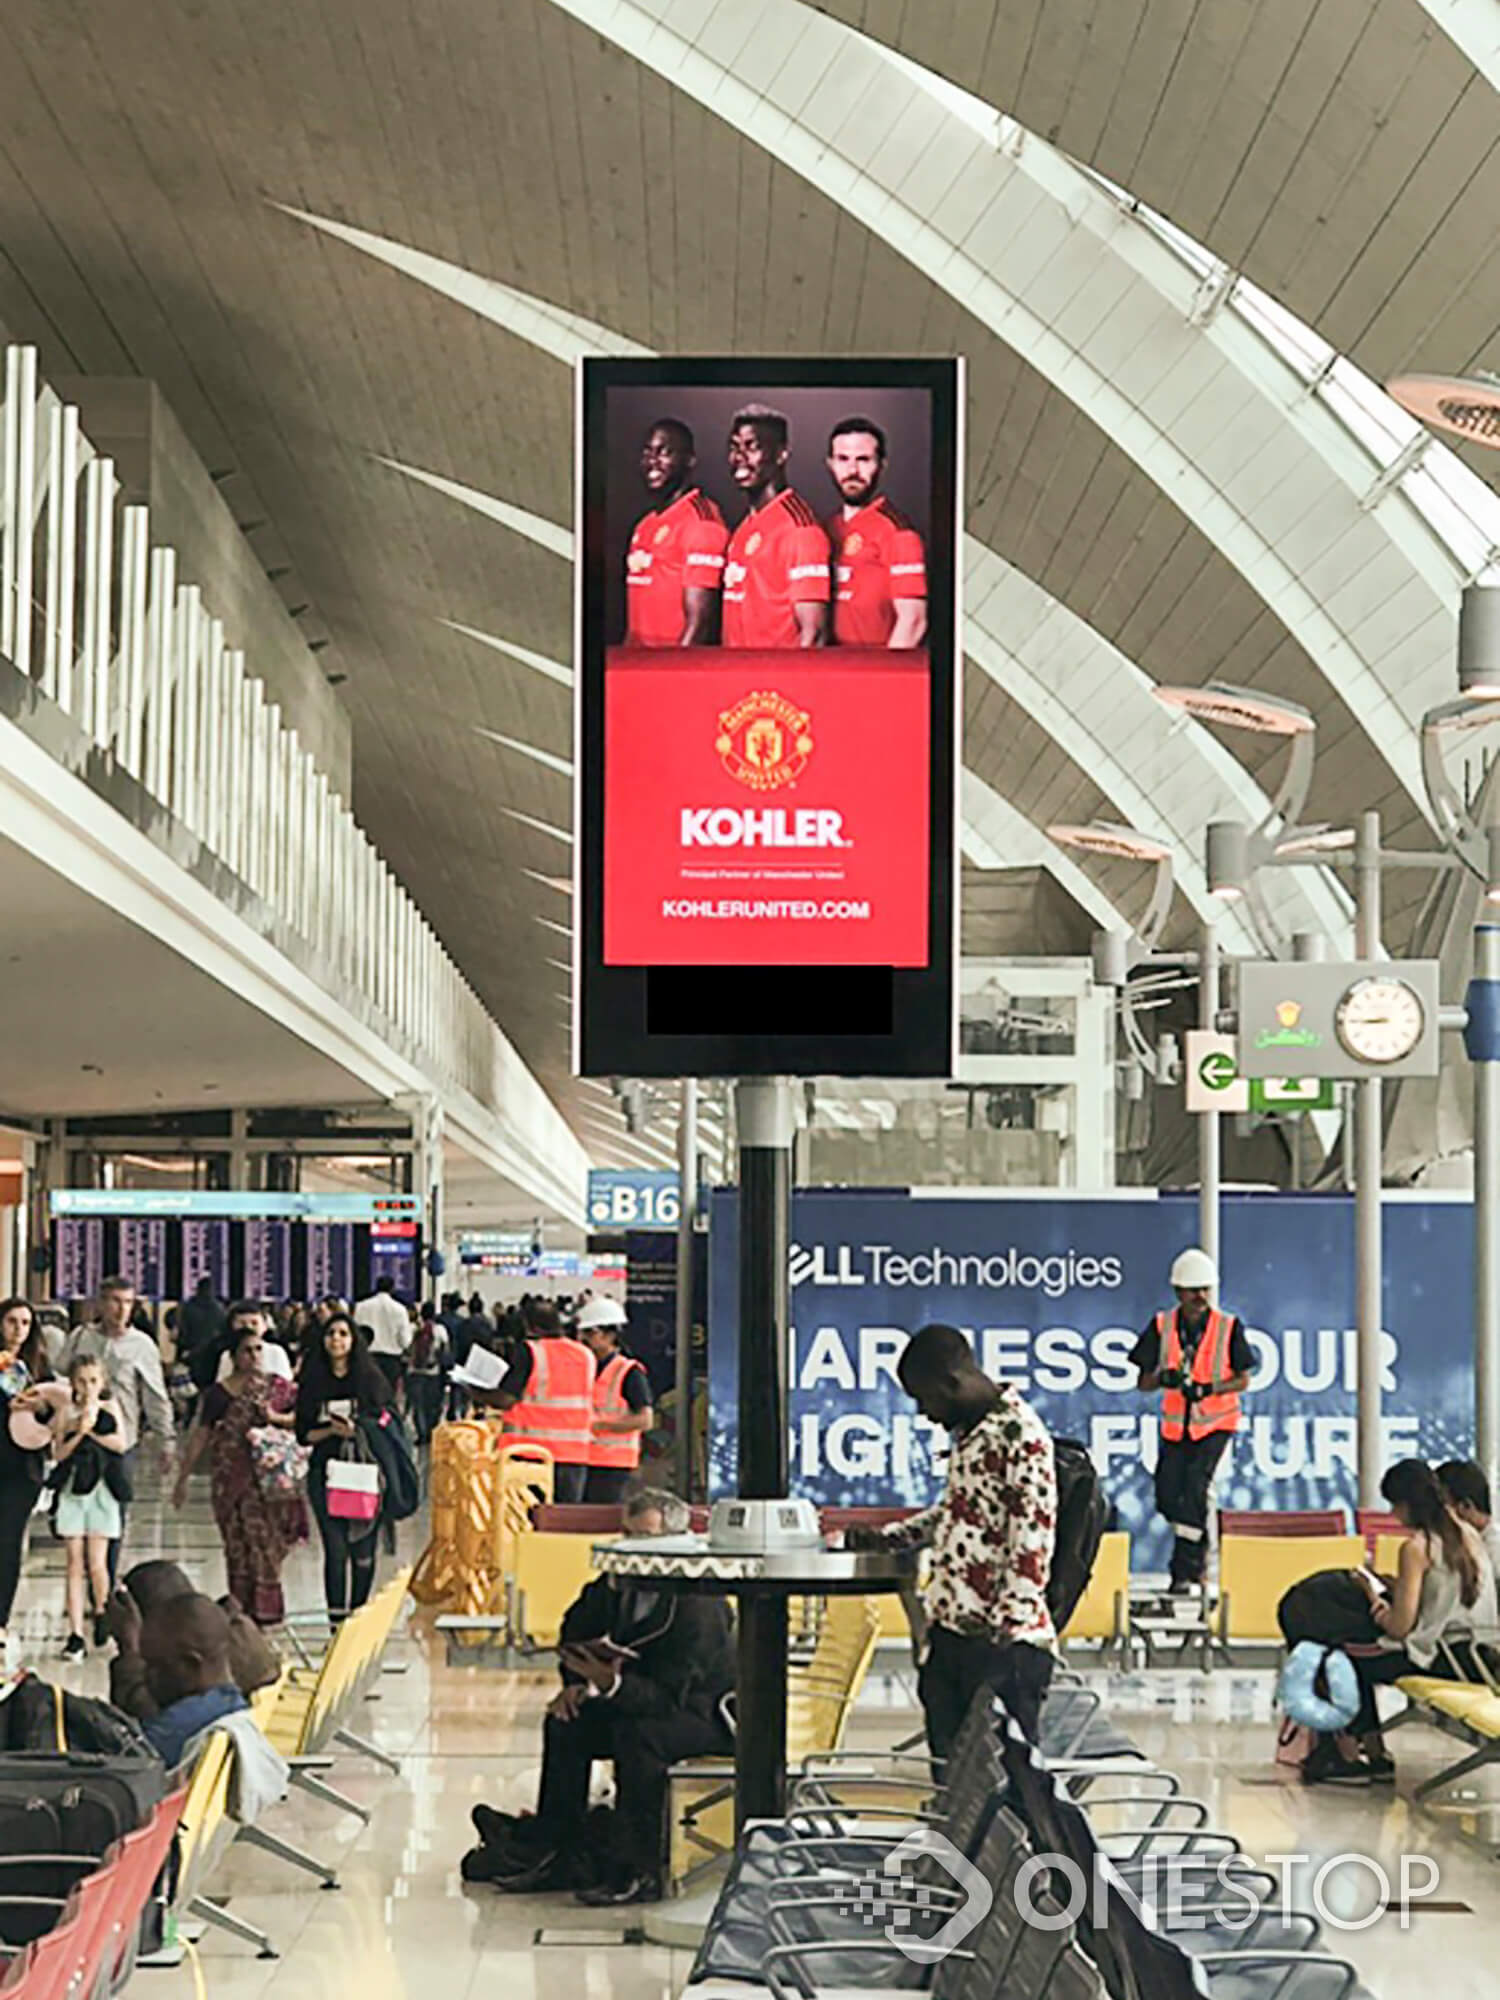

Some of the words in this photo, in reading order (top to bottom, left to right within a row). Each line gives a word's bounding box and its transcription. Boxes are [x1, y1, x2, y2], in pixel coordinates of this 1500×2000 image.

[681, 808, 847, 847] KOHLER
[662, 900, 870, 919] KOHLERUNITED.COM
[613, 1186, 680, 1222] B16
[863, 1246, 1122, 1297] Technologies
[789, 1327, 1142, 1392] ARESS
